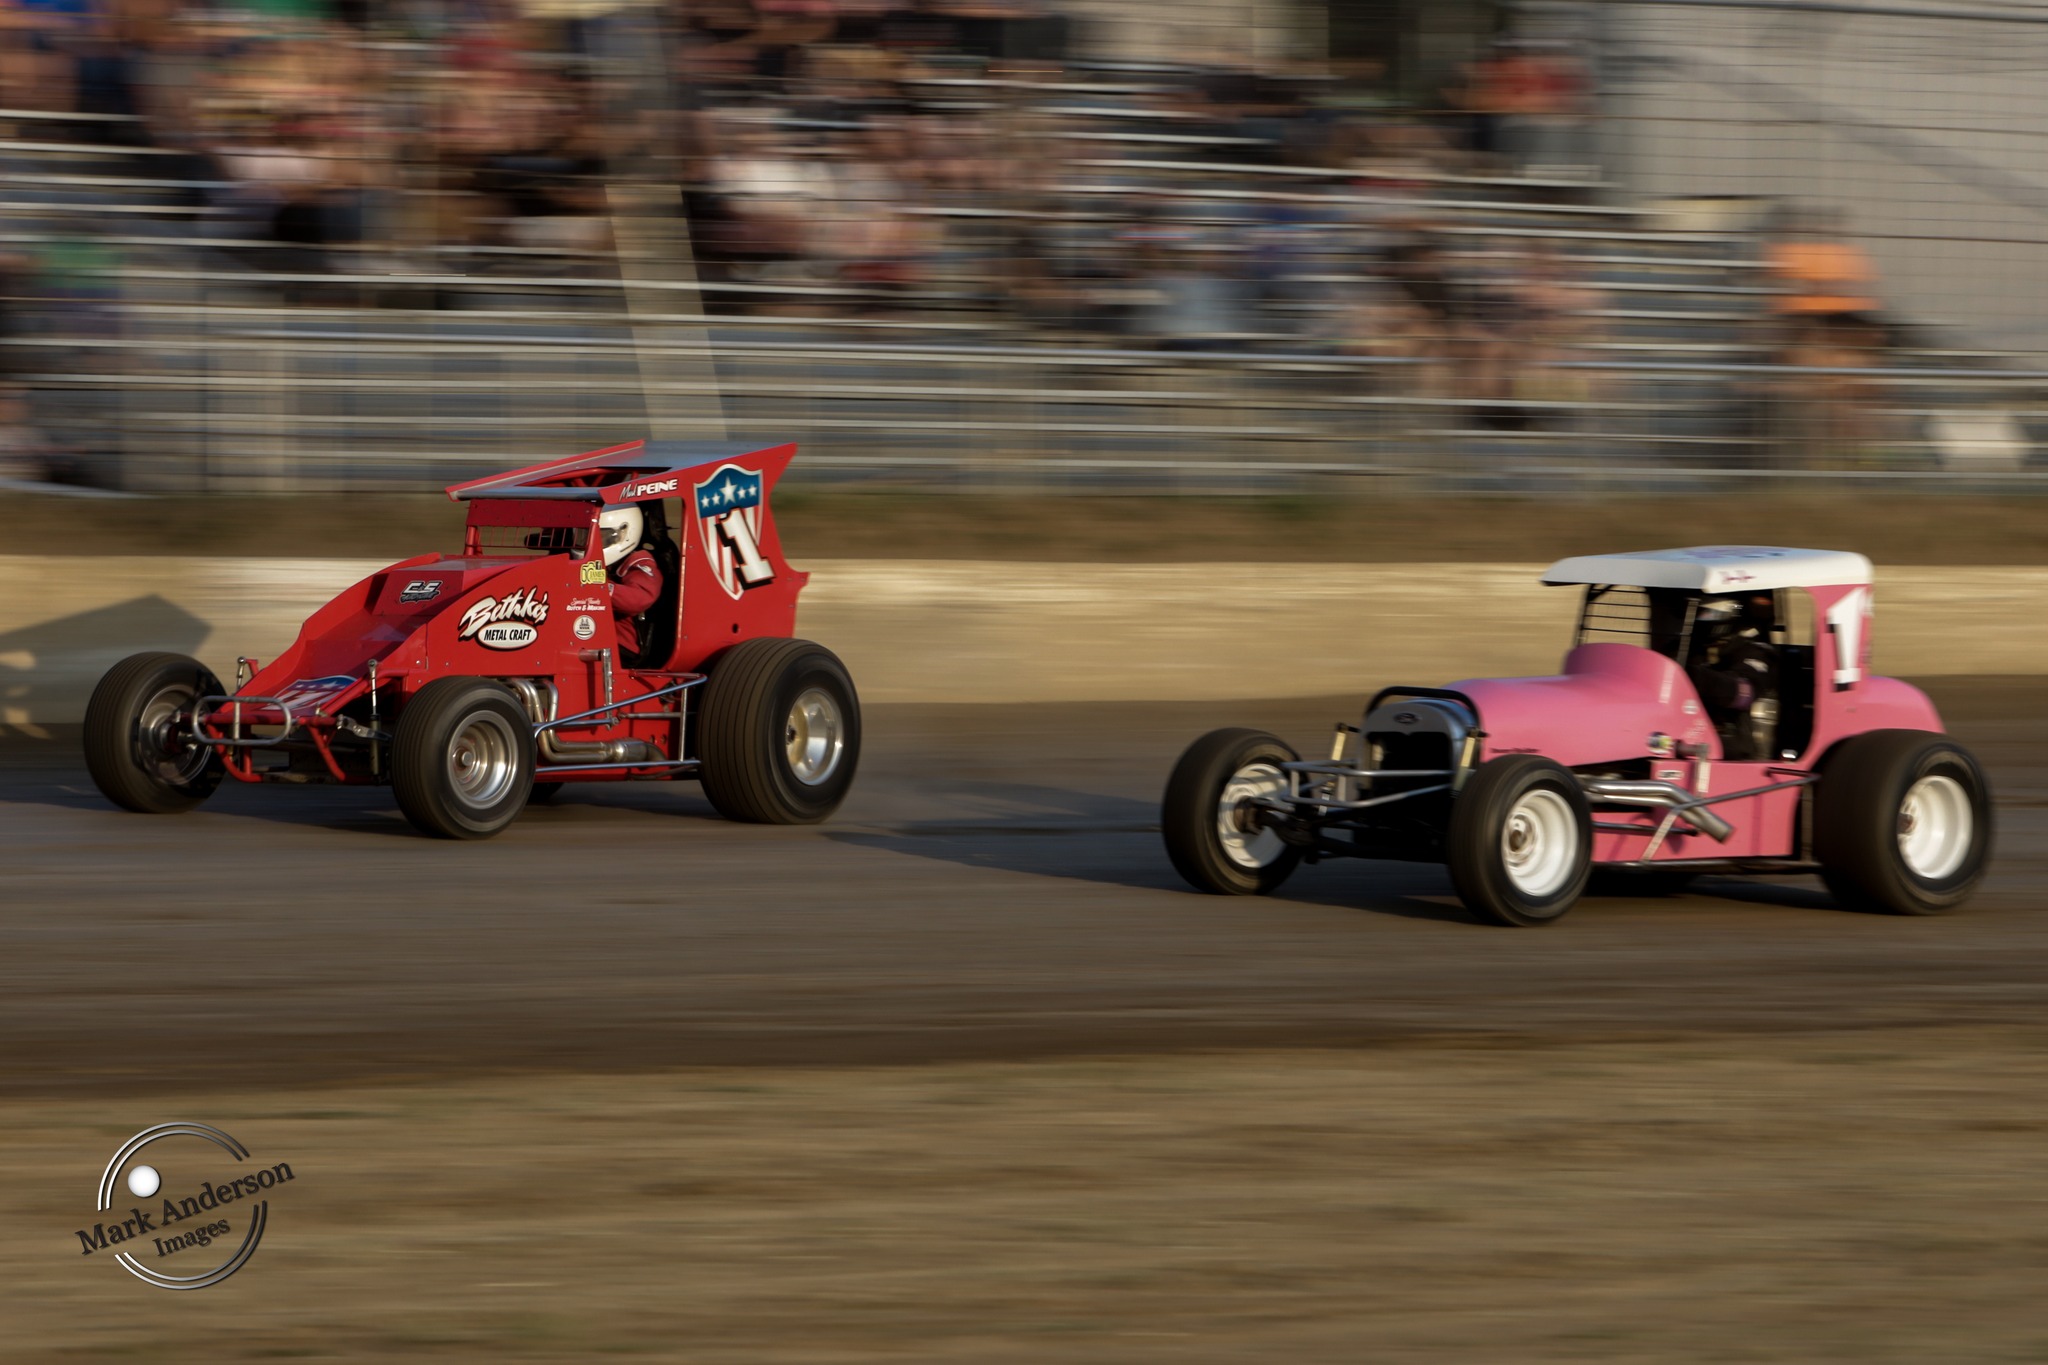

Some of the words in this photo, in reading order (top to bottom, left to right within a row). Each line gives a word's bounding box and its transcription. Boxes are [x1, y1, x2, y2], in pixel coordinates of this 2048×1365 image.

[637, 479, 678, 496] PEINE
[718, 507, 776, 586] 1
[458, 586, 550, 638] Bethke's
[484, 629, 508, 641] METAL
[509, 629, 532, 641] CRAFT
